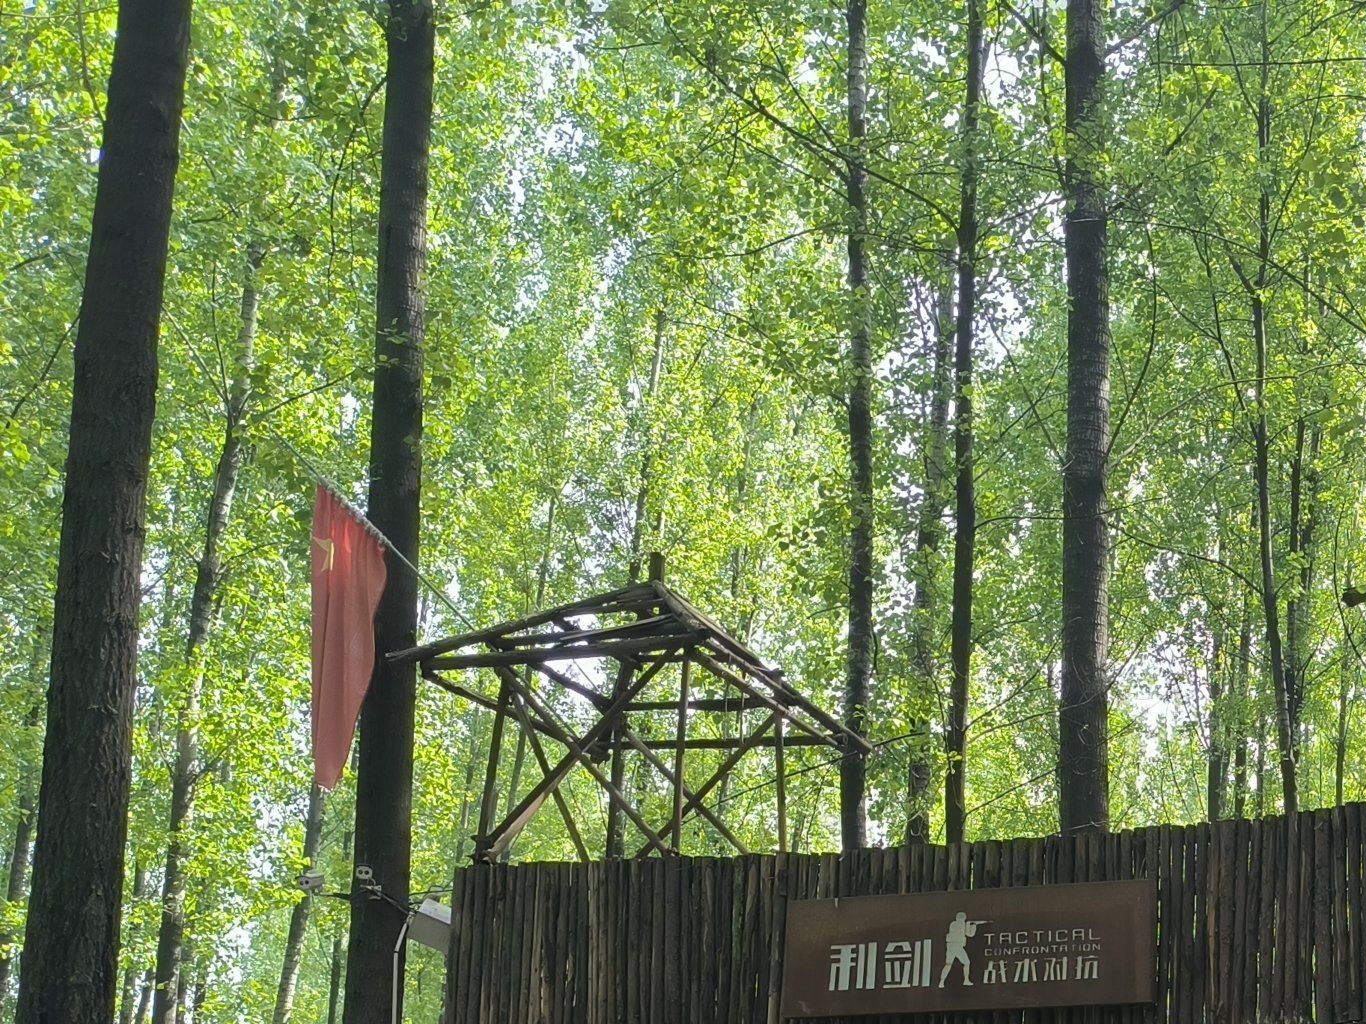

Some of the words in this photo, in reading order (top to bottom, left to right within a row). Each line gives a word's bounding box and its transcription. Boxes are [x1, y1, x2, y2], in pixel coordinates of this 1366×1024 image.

[983, 928, 1101, 946] TACTICAL
[984, 943, 1101, 957] CONFRONTATION
[829, 939, 932, 991] 利剑
[983, 955, 1100, 984] 战术对抗
